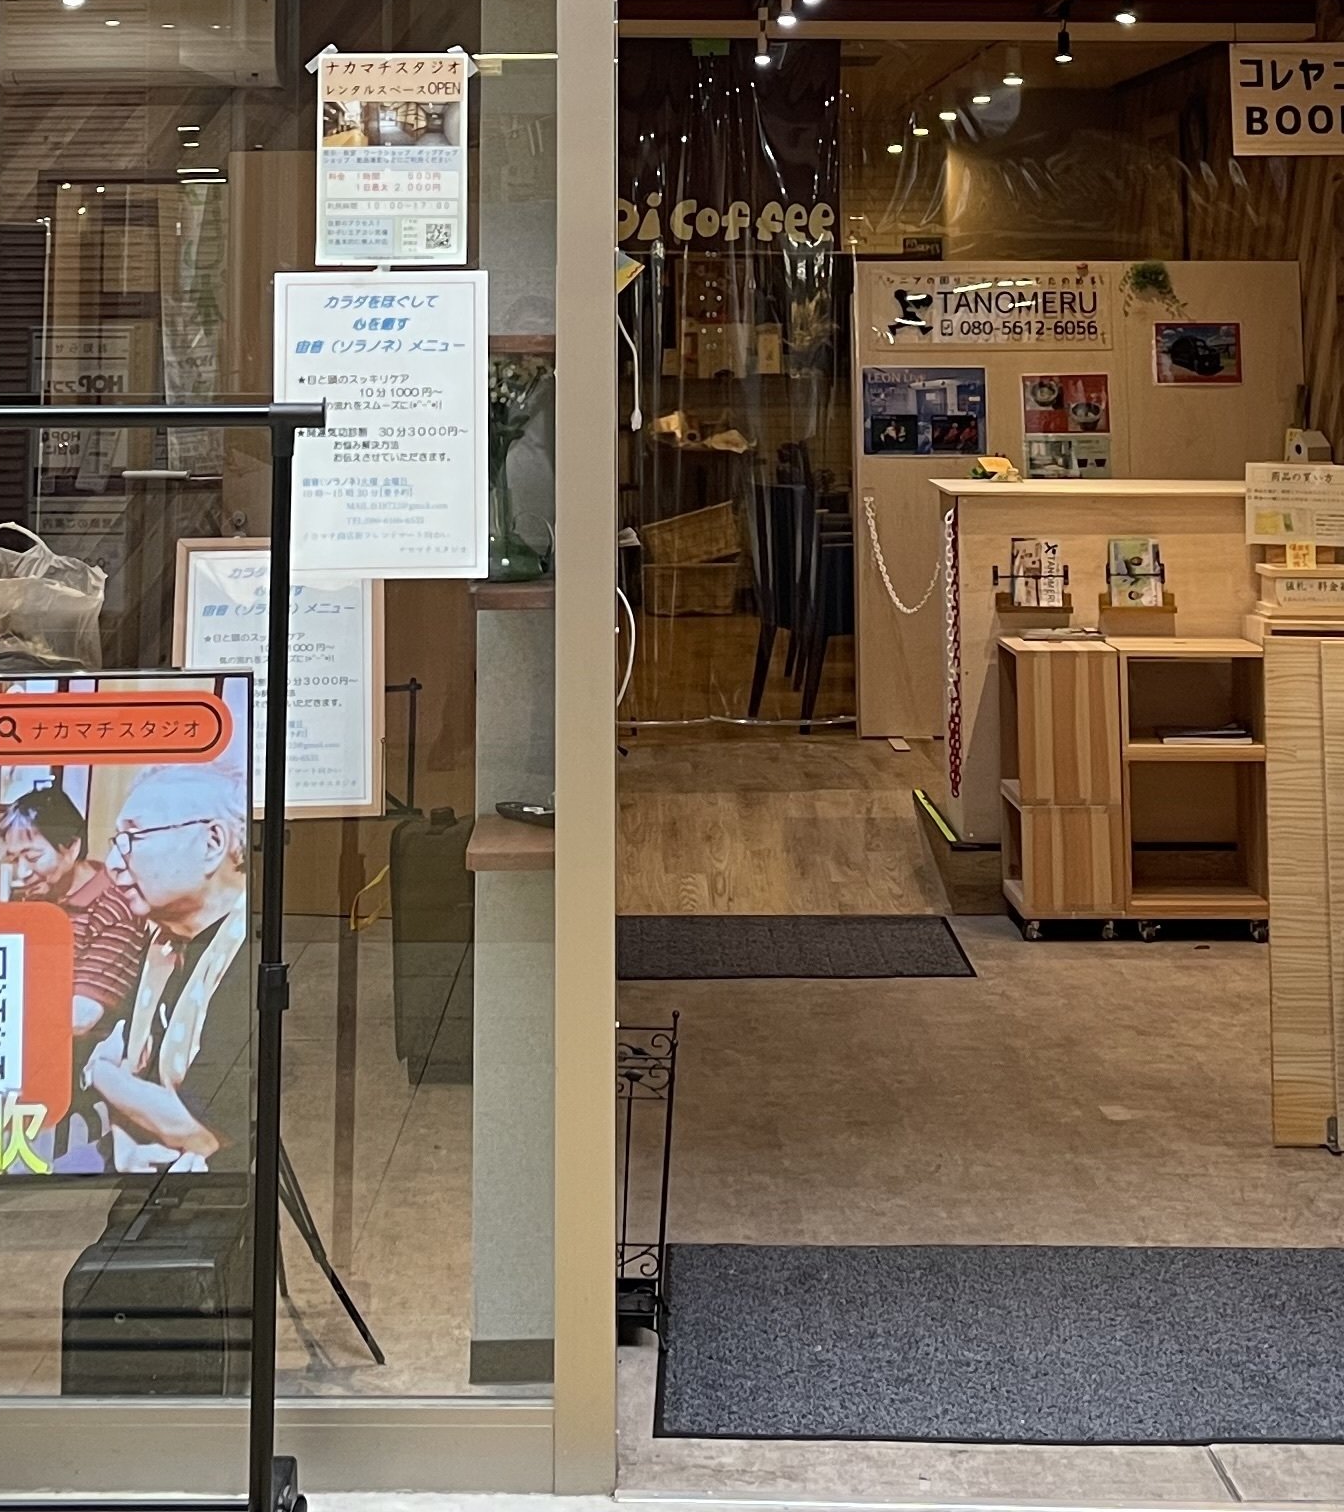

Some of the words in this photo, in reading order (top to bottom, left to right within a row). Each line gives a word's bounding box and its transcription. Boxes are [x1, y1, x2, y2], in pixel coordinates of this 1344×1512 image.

[325, 61, 462, 75] ナカマチスタジオ
[323, 295, 440, 309] カラダをほぐして
[937, 291, 1097, 314] TANOMERU
[960, 320, 1098, 336] 080-5612-6056
[31, 718, 200, 741] ナカマチスタジオ
